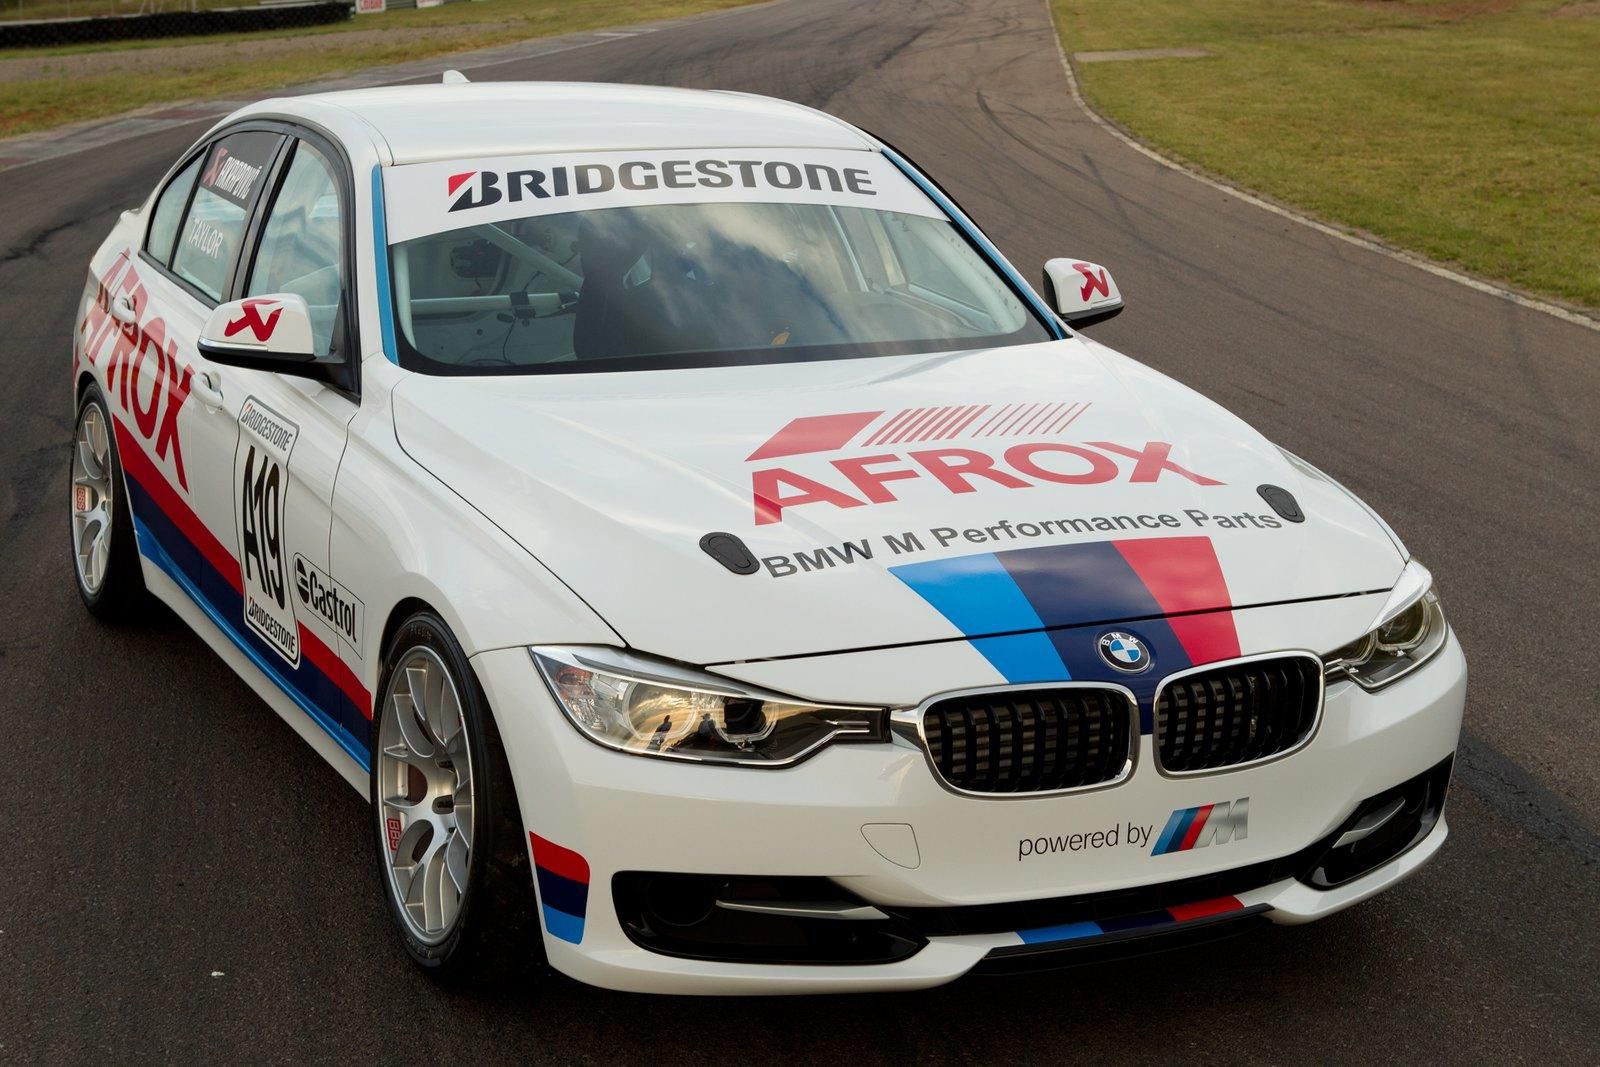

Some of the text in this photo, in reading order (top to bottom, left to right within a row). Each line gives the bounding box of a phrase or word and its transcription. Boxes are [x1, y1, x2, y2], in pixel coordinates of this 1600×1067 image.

[448, 159, 878, 213] BRIDGESTONE
[189, 219, 225, 260] TAYLOR
[240, 402, 294, 452] BRIDGESTONE
[752, 440, 1228, 526] AFROX
[242, 445, 285, 611] A19
[761, 509, 1283, 578] BMW M Performance Parts
[247, 596, 297, 655] BRIDGESTONE
[308, 570, 358, 644] Castrol
[1101, 633, 1139, 647] BMW
[1018, 823, 1120, 861] powered
[1127, 821, 1153, 848] by
